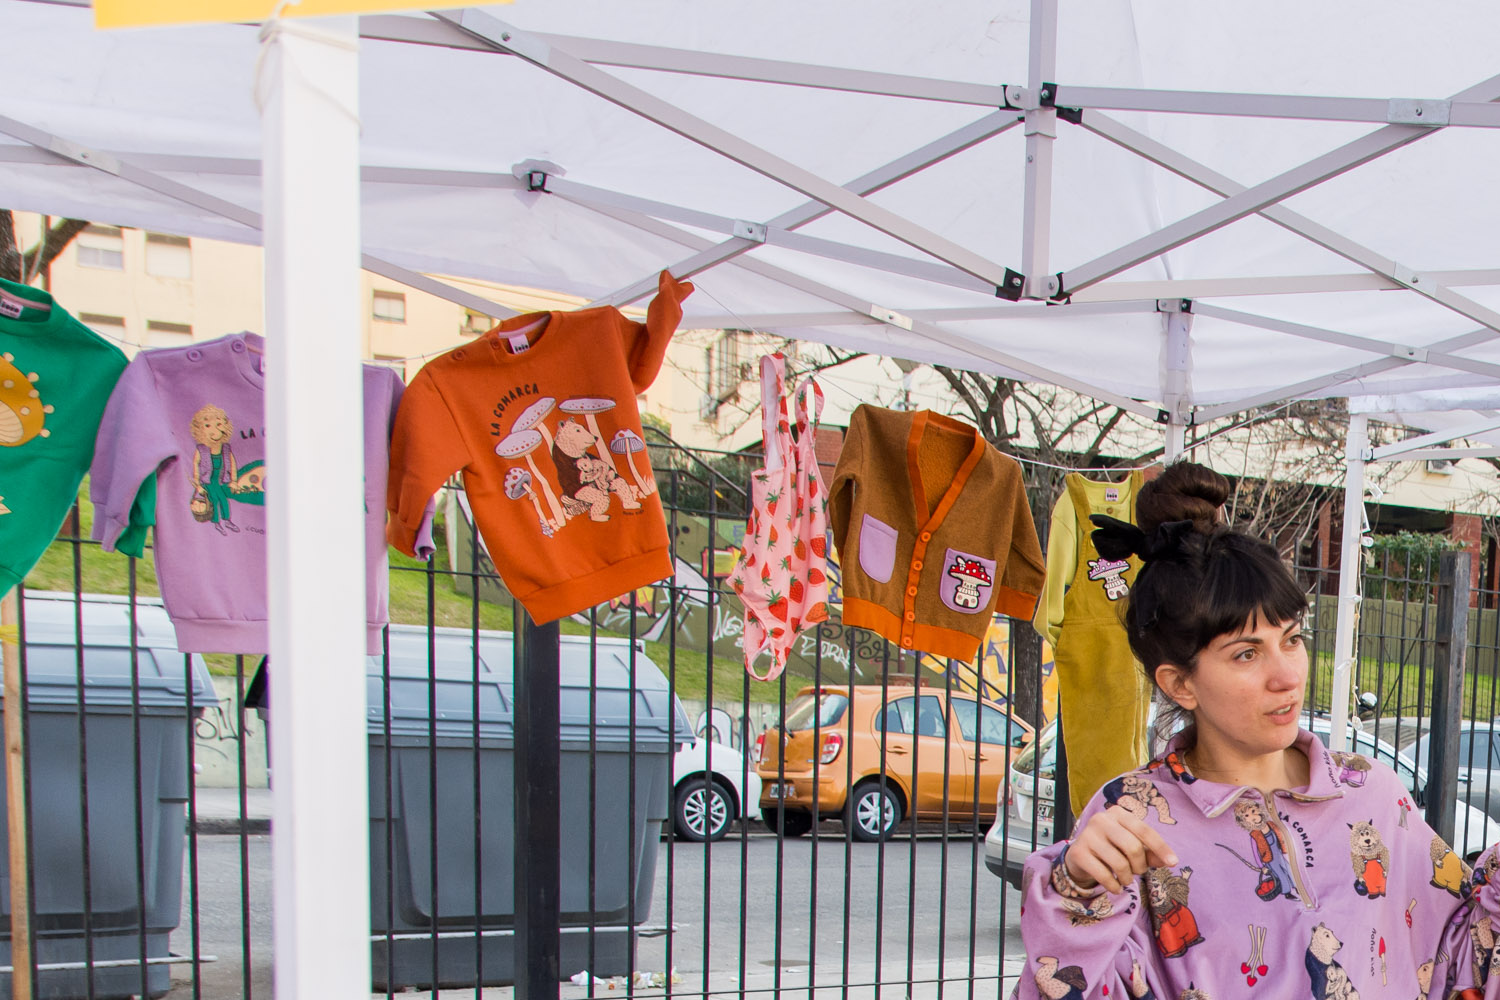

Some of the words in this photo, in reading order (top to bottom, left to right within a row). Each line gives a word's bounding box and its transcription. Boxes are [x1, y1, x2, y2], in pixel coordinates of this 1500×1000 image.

[493, 383, 540, 418] COMARCA
[240, 428, 256, 440] LA
[491, 422, 501, 437] LA
[1278, 811, 1290, 823] LA
[1292, 821, 1315, 868] COMARCA
